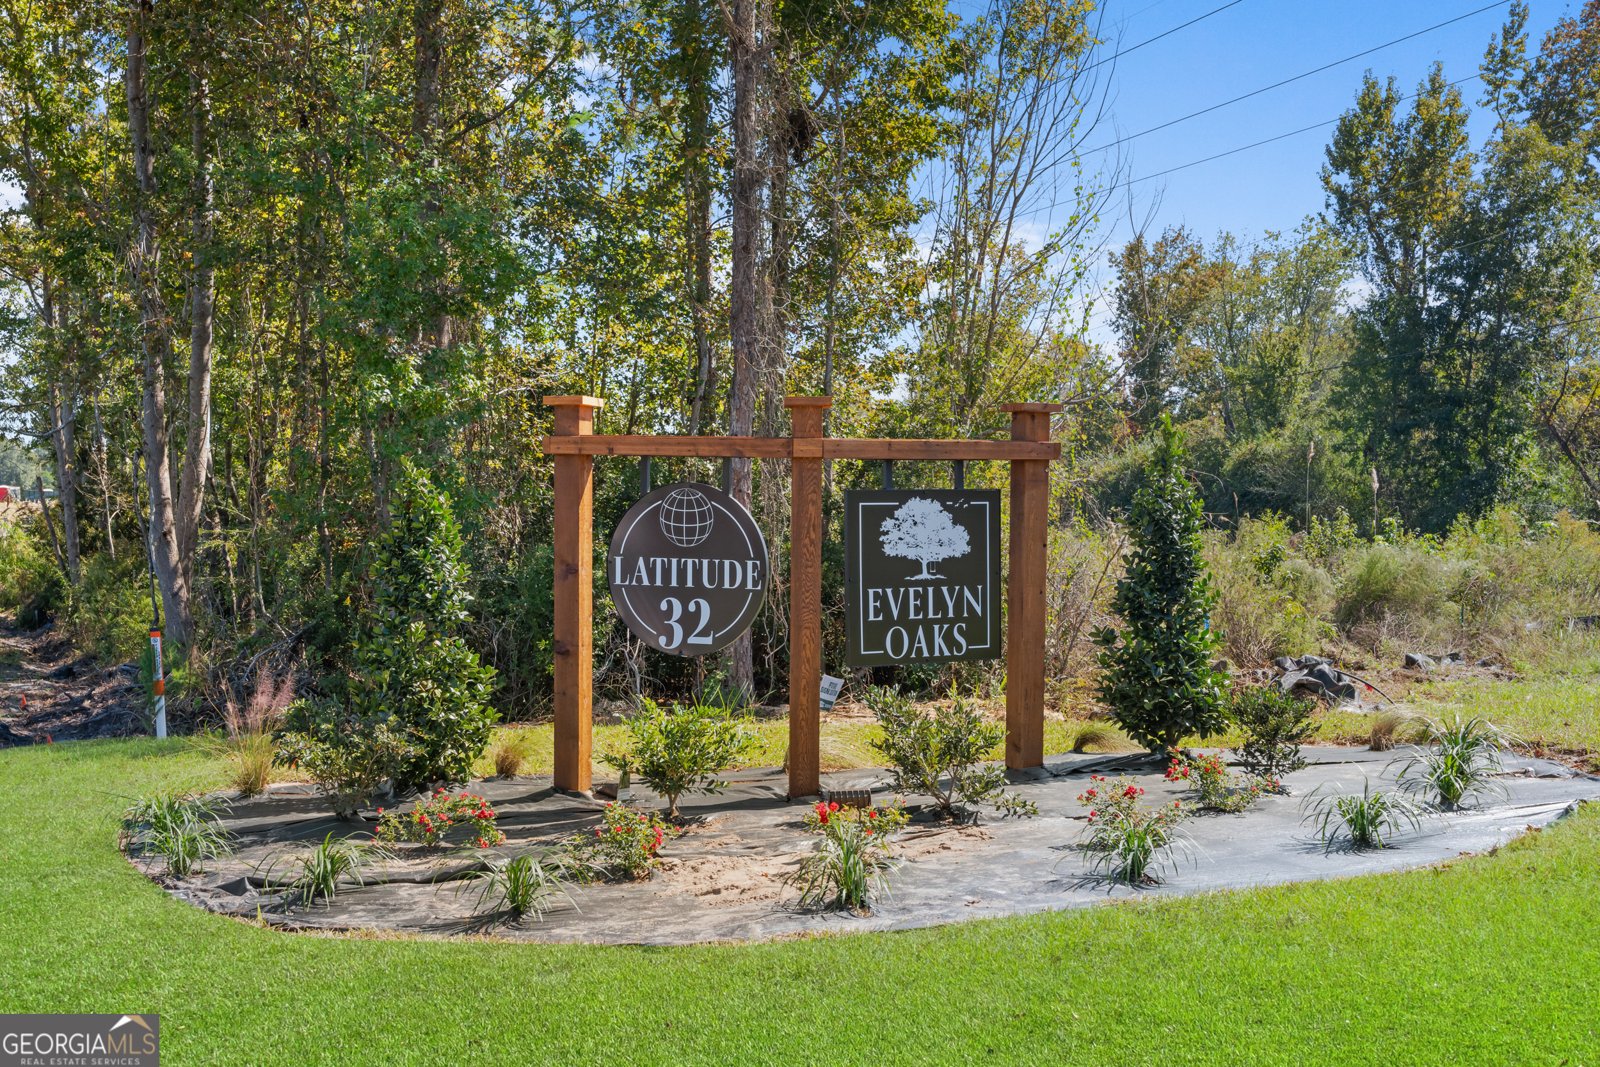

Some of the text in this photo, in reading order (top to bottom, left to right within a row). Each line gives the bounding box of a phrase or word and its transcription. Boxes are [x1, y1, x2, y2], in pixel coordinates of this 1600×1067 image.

[613, 556, 762, 590] LATITUDE
[867, 585, 983, 621] EVELYN
[658, 597, 713, 649] 32
[885, 623, 967, 659] OAKS
